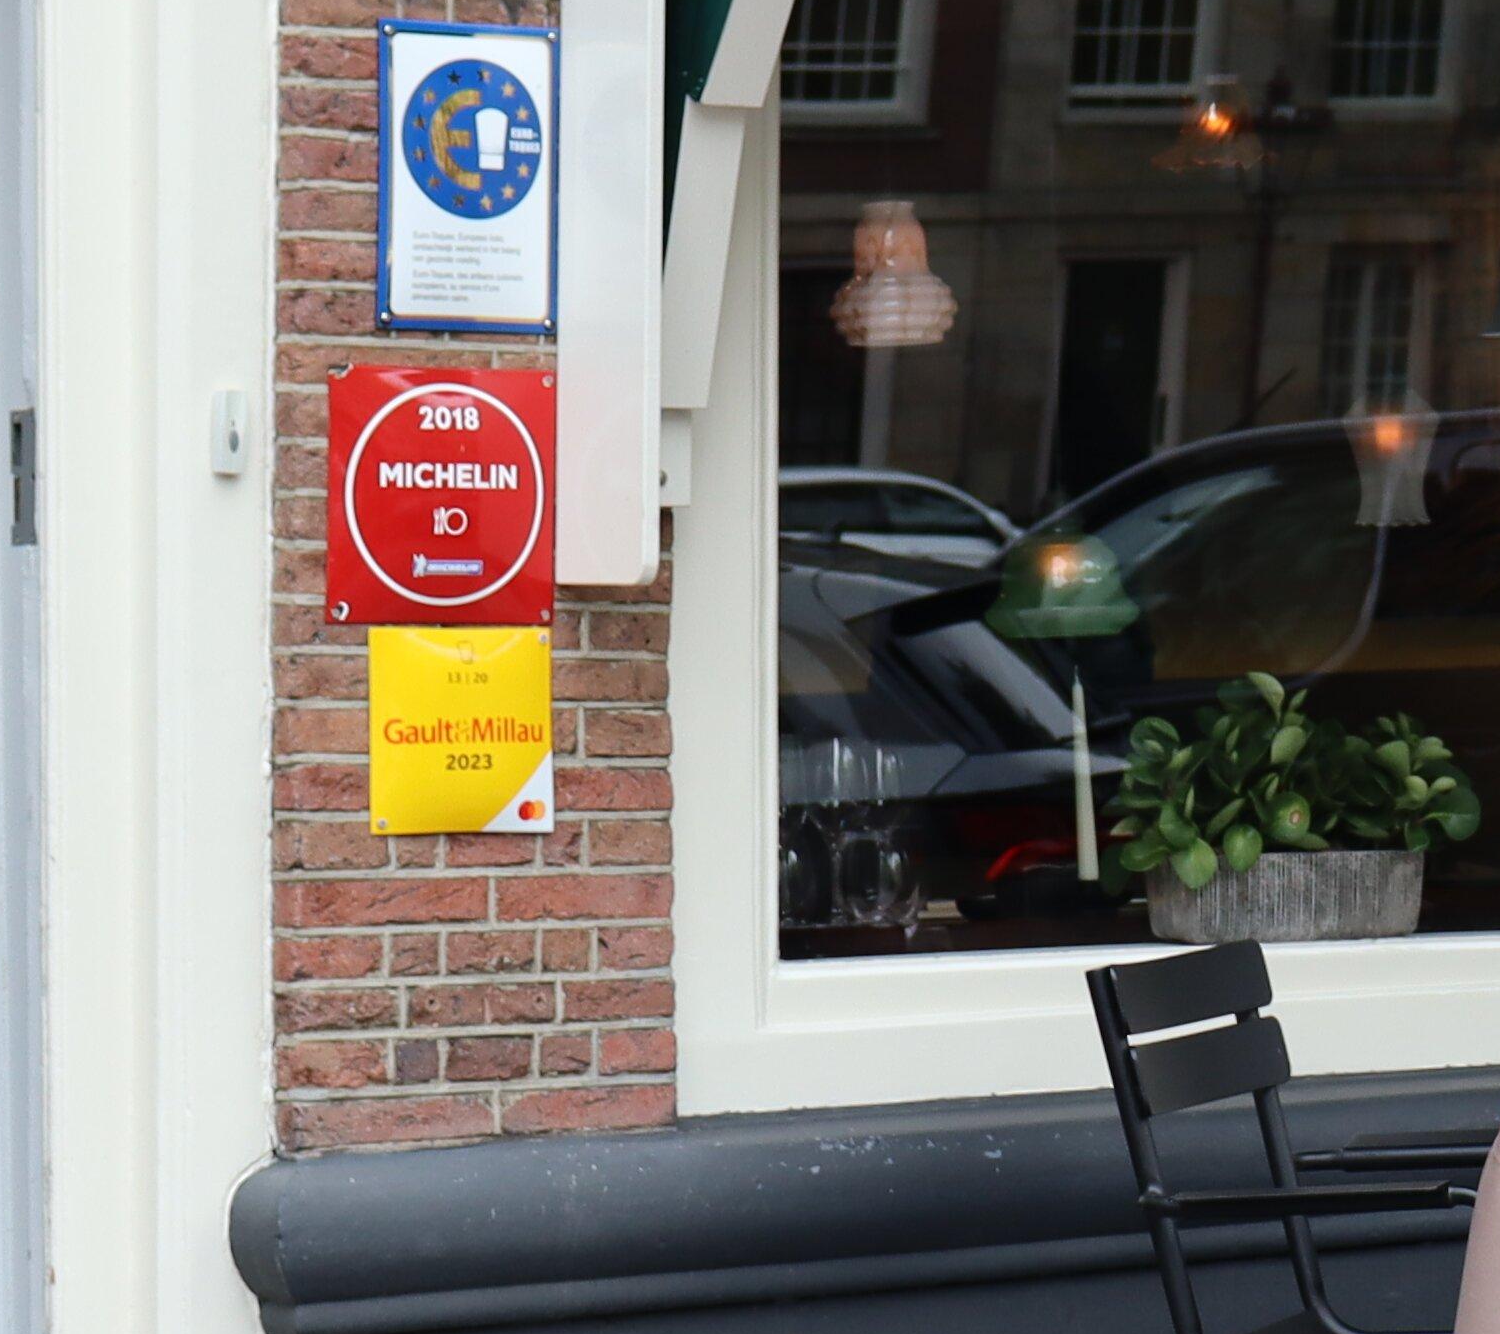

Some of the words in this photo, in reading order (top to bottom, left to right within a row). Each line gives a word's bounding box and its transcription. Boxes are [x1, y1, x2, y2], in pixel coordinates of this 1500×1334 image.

[418, 405, 480, 431] 2018
[378, 462, 518, 490] MICHELIN
[473, 671, 489, 684] 20
[445, 753, 494, 771] 2023
